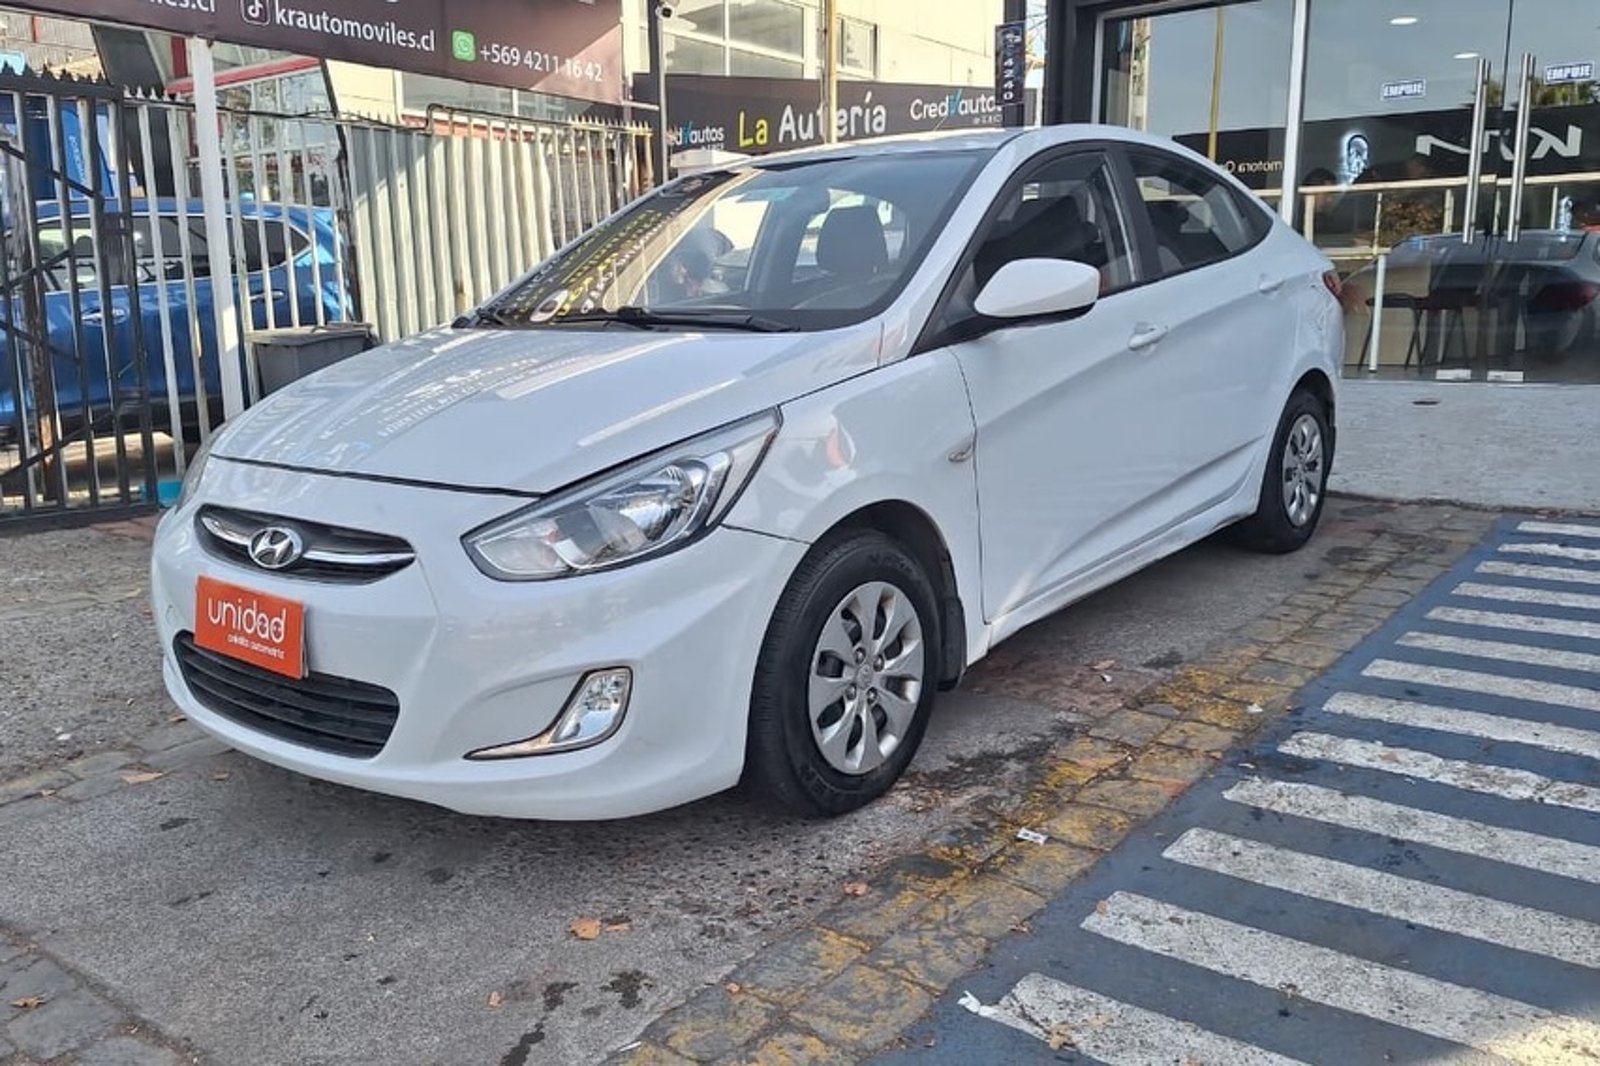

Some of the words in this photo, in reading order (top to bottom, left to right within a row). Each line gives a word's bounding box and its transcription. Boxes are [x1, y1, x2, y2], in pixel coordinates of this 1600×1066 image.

[274, 0, 435, 52] krautomoviles.cl
[480, 43, 521, 66] +569
[523, 50, 559, 74] 4211
[565, 58, 583, 77] 16
[584, 60, 603, 81] 42
[1547, 65, 1590, 80] EMPUJE
[739, 110, 768, 147] La
[778, 91, 886, 143] Autería
[207, 598, 287, 643] unidad
